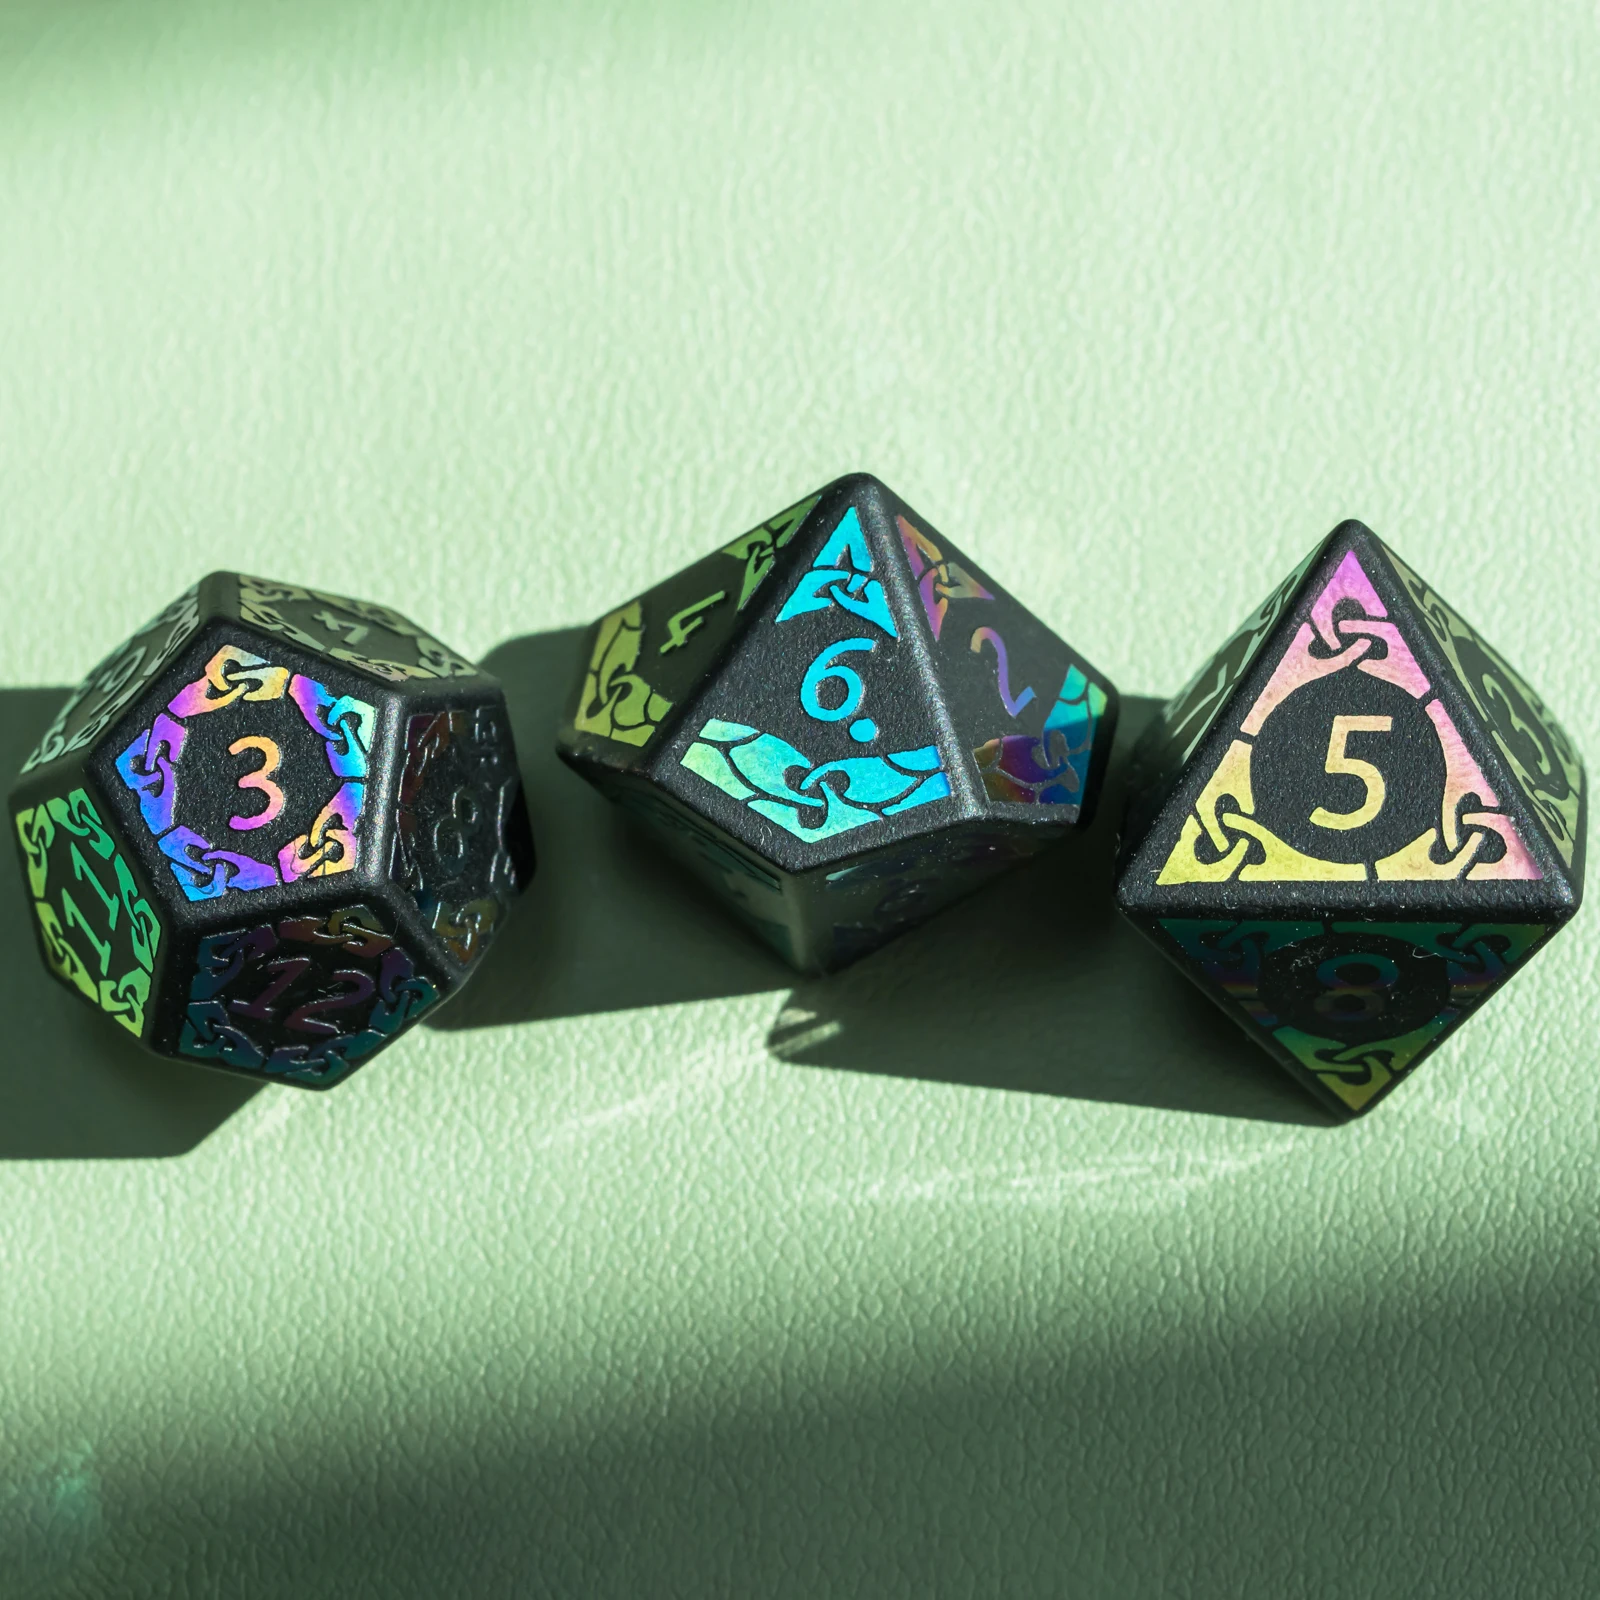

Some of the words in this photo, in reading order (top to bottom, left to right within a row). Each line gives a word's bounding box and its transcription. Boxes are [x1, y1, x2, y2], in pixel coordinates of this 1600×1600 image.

[660, 590, 726, 653] 4
[970, 627, 1036, 718] 2
[1482, 672, 1551, 776] 3
[228, 734, 285, 831] 3
[1308, 715, 1394, 831] 5
[61, 843, 120, 976] 11
[231, 957, 376, 1035] 12
[1313, 953, 1401, 1023] 8
